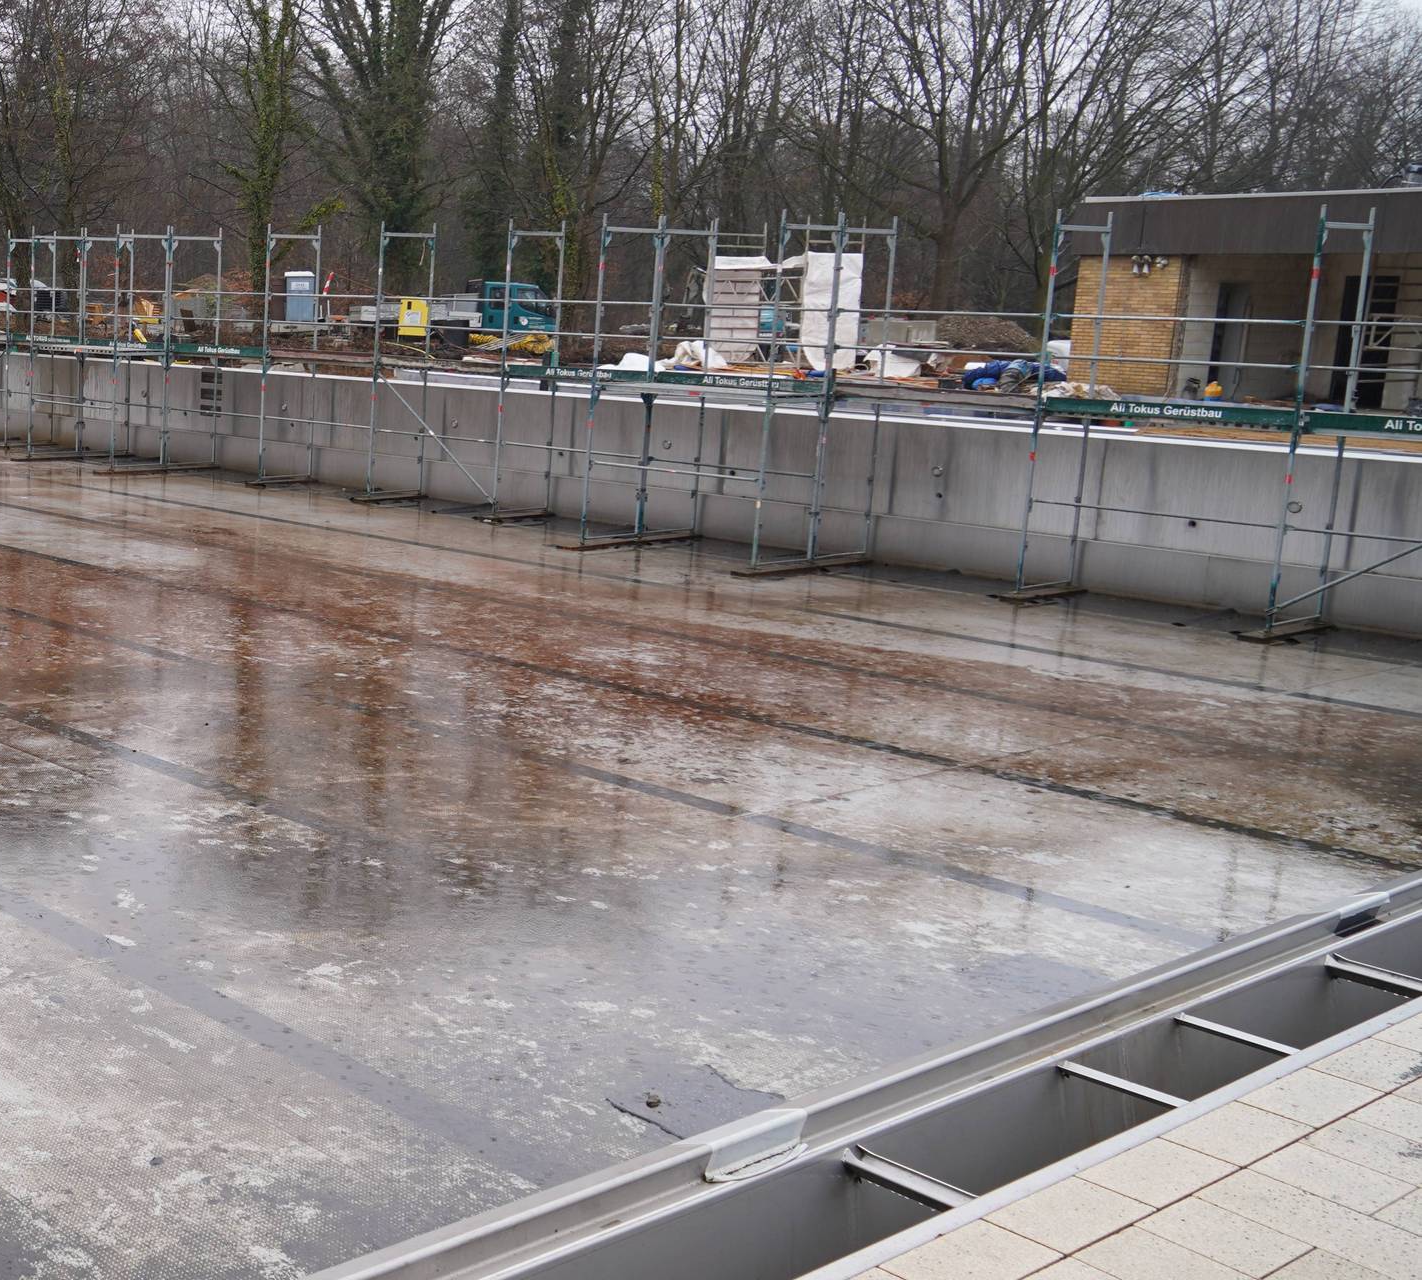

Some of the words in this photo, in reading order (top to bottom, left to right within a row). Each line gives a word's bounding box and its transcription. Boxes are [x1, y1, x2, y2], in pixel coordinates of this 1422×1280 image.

[556, 368, 575, 377] Tokus
[577, 369, 612, 378] Gerütbau
[703, 376, 713, 384] Ali
[715, 376, 737, 386] Tokus
[1110, 402, 1125, 413] Ali
[1129, 403, 1160, 415] Tokus
[1163, 405, 1222, 418] Gerüstbau
[1384, 419, 1403, 430] Ali
